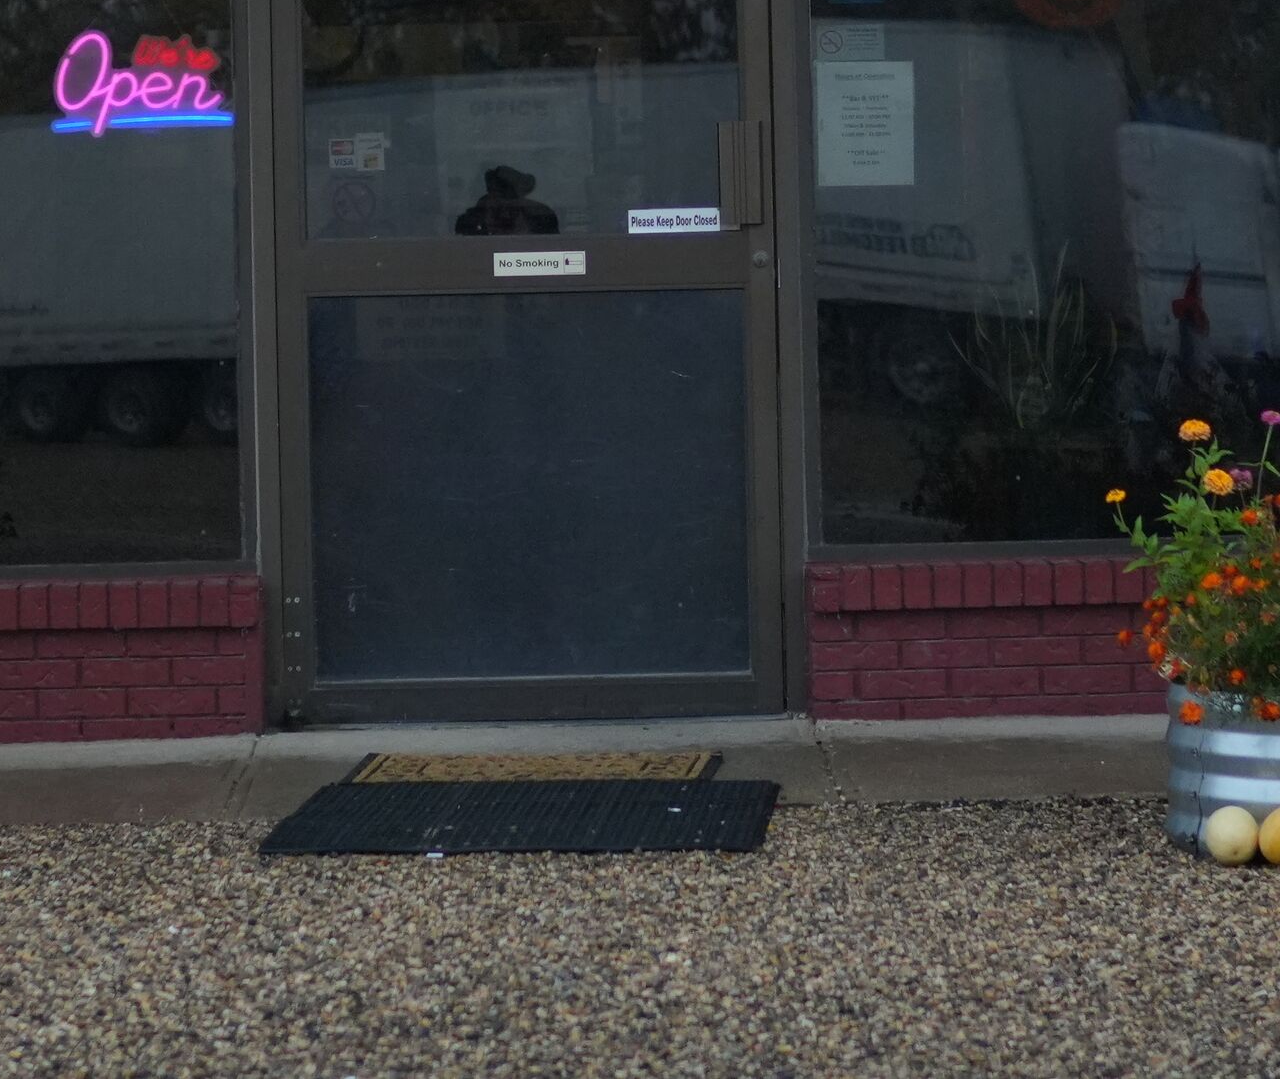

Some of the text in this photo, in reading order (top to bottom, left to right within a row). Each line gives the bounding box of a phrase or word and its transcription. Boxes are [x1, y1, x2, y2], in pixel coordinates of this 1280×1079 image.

[57, 33, 223, 135] Open
[334, 157, 354, 167] VISA
[631, 214, 718, 229] Please Keep Door Closed
[499, 259, 560, 269] No Smoking
